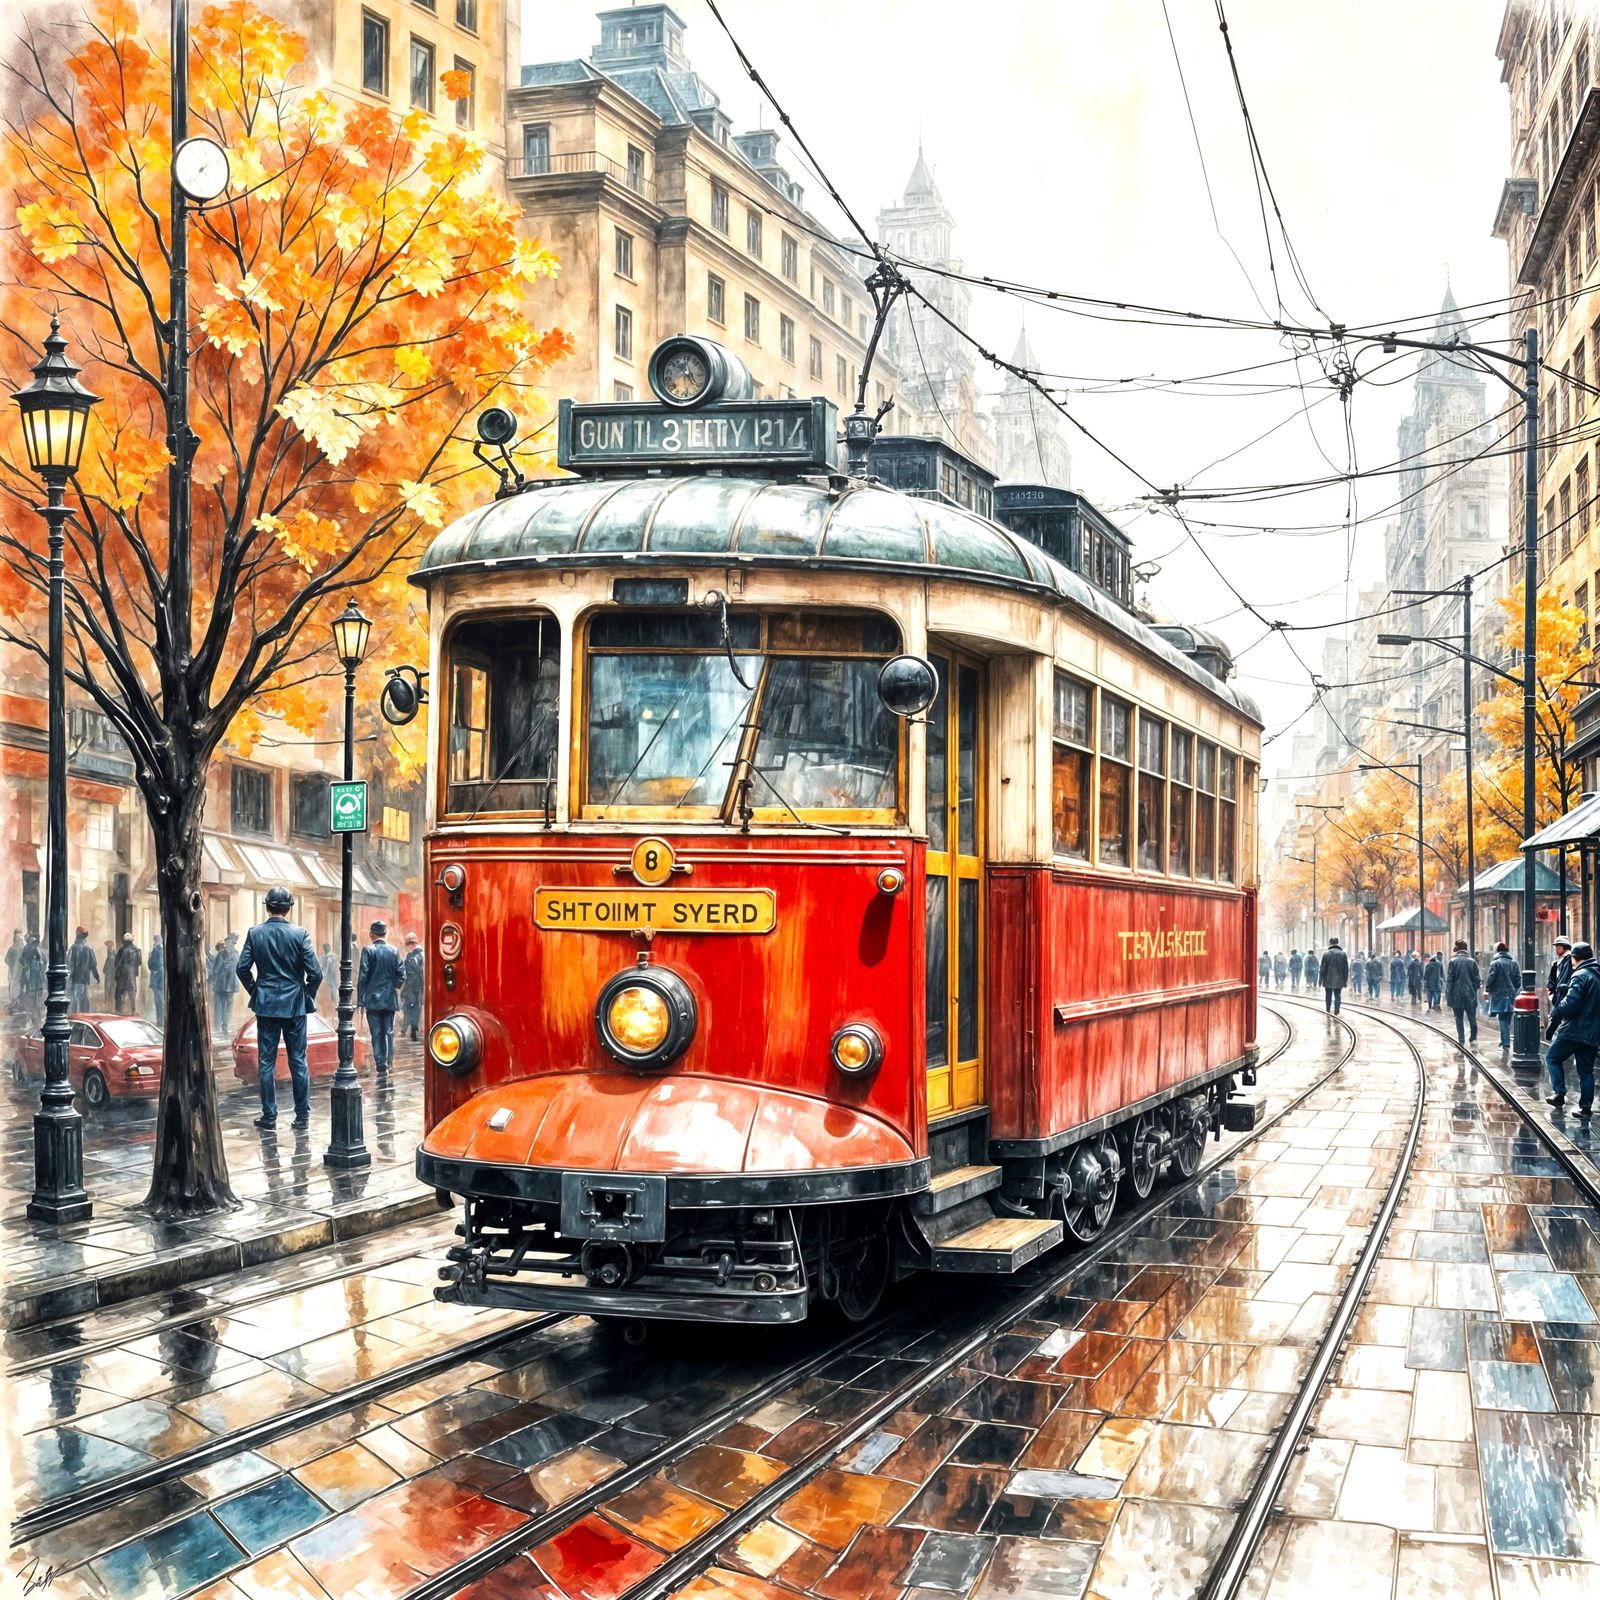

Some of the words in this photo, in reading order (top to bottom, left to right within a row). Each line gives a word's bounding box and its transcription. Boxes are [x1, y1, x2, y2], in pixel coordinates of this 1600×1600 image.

[580, 418, 625, 450] GUN
[645, 849, 658, 871] 8
[672, 902, 758, 924] SYERD
